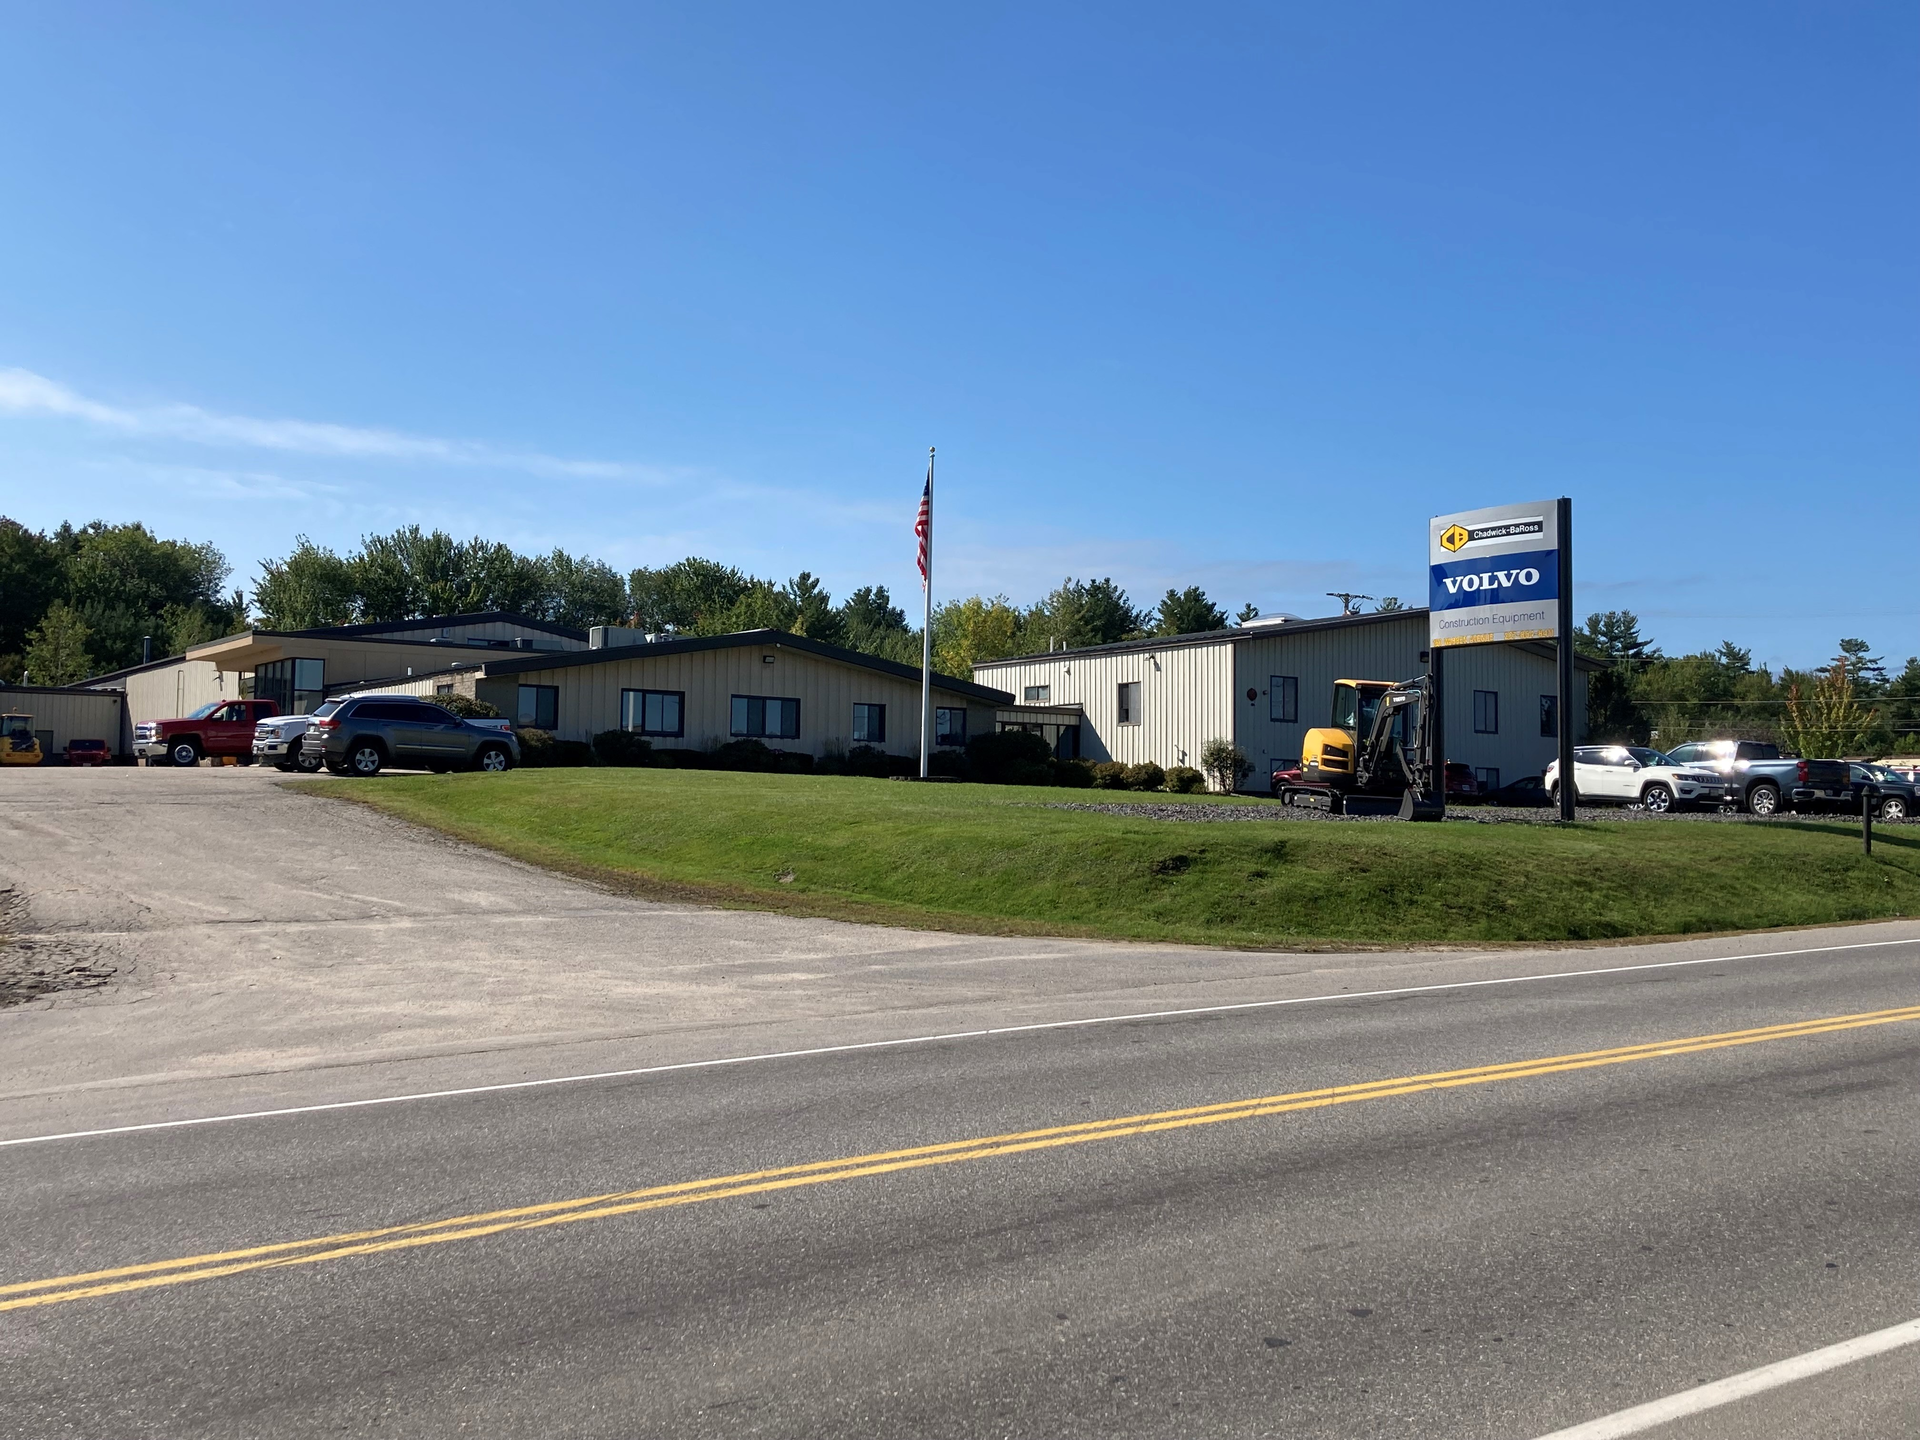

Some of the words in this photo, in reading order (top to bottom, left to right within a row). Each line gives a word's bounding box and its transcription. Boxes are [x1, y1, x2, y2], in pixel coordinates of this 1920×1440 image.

[1474, 525, 1539, 539] Chadwick-BaRoss
[1443, 567, 1540, 594] VOLVO
[1439, 615, 1490, 630] Construction
[1493, 611, 1545, 625] Equipment
